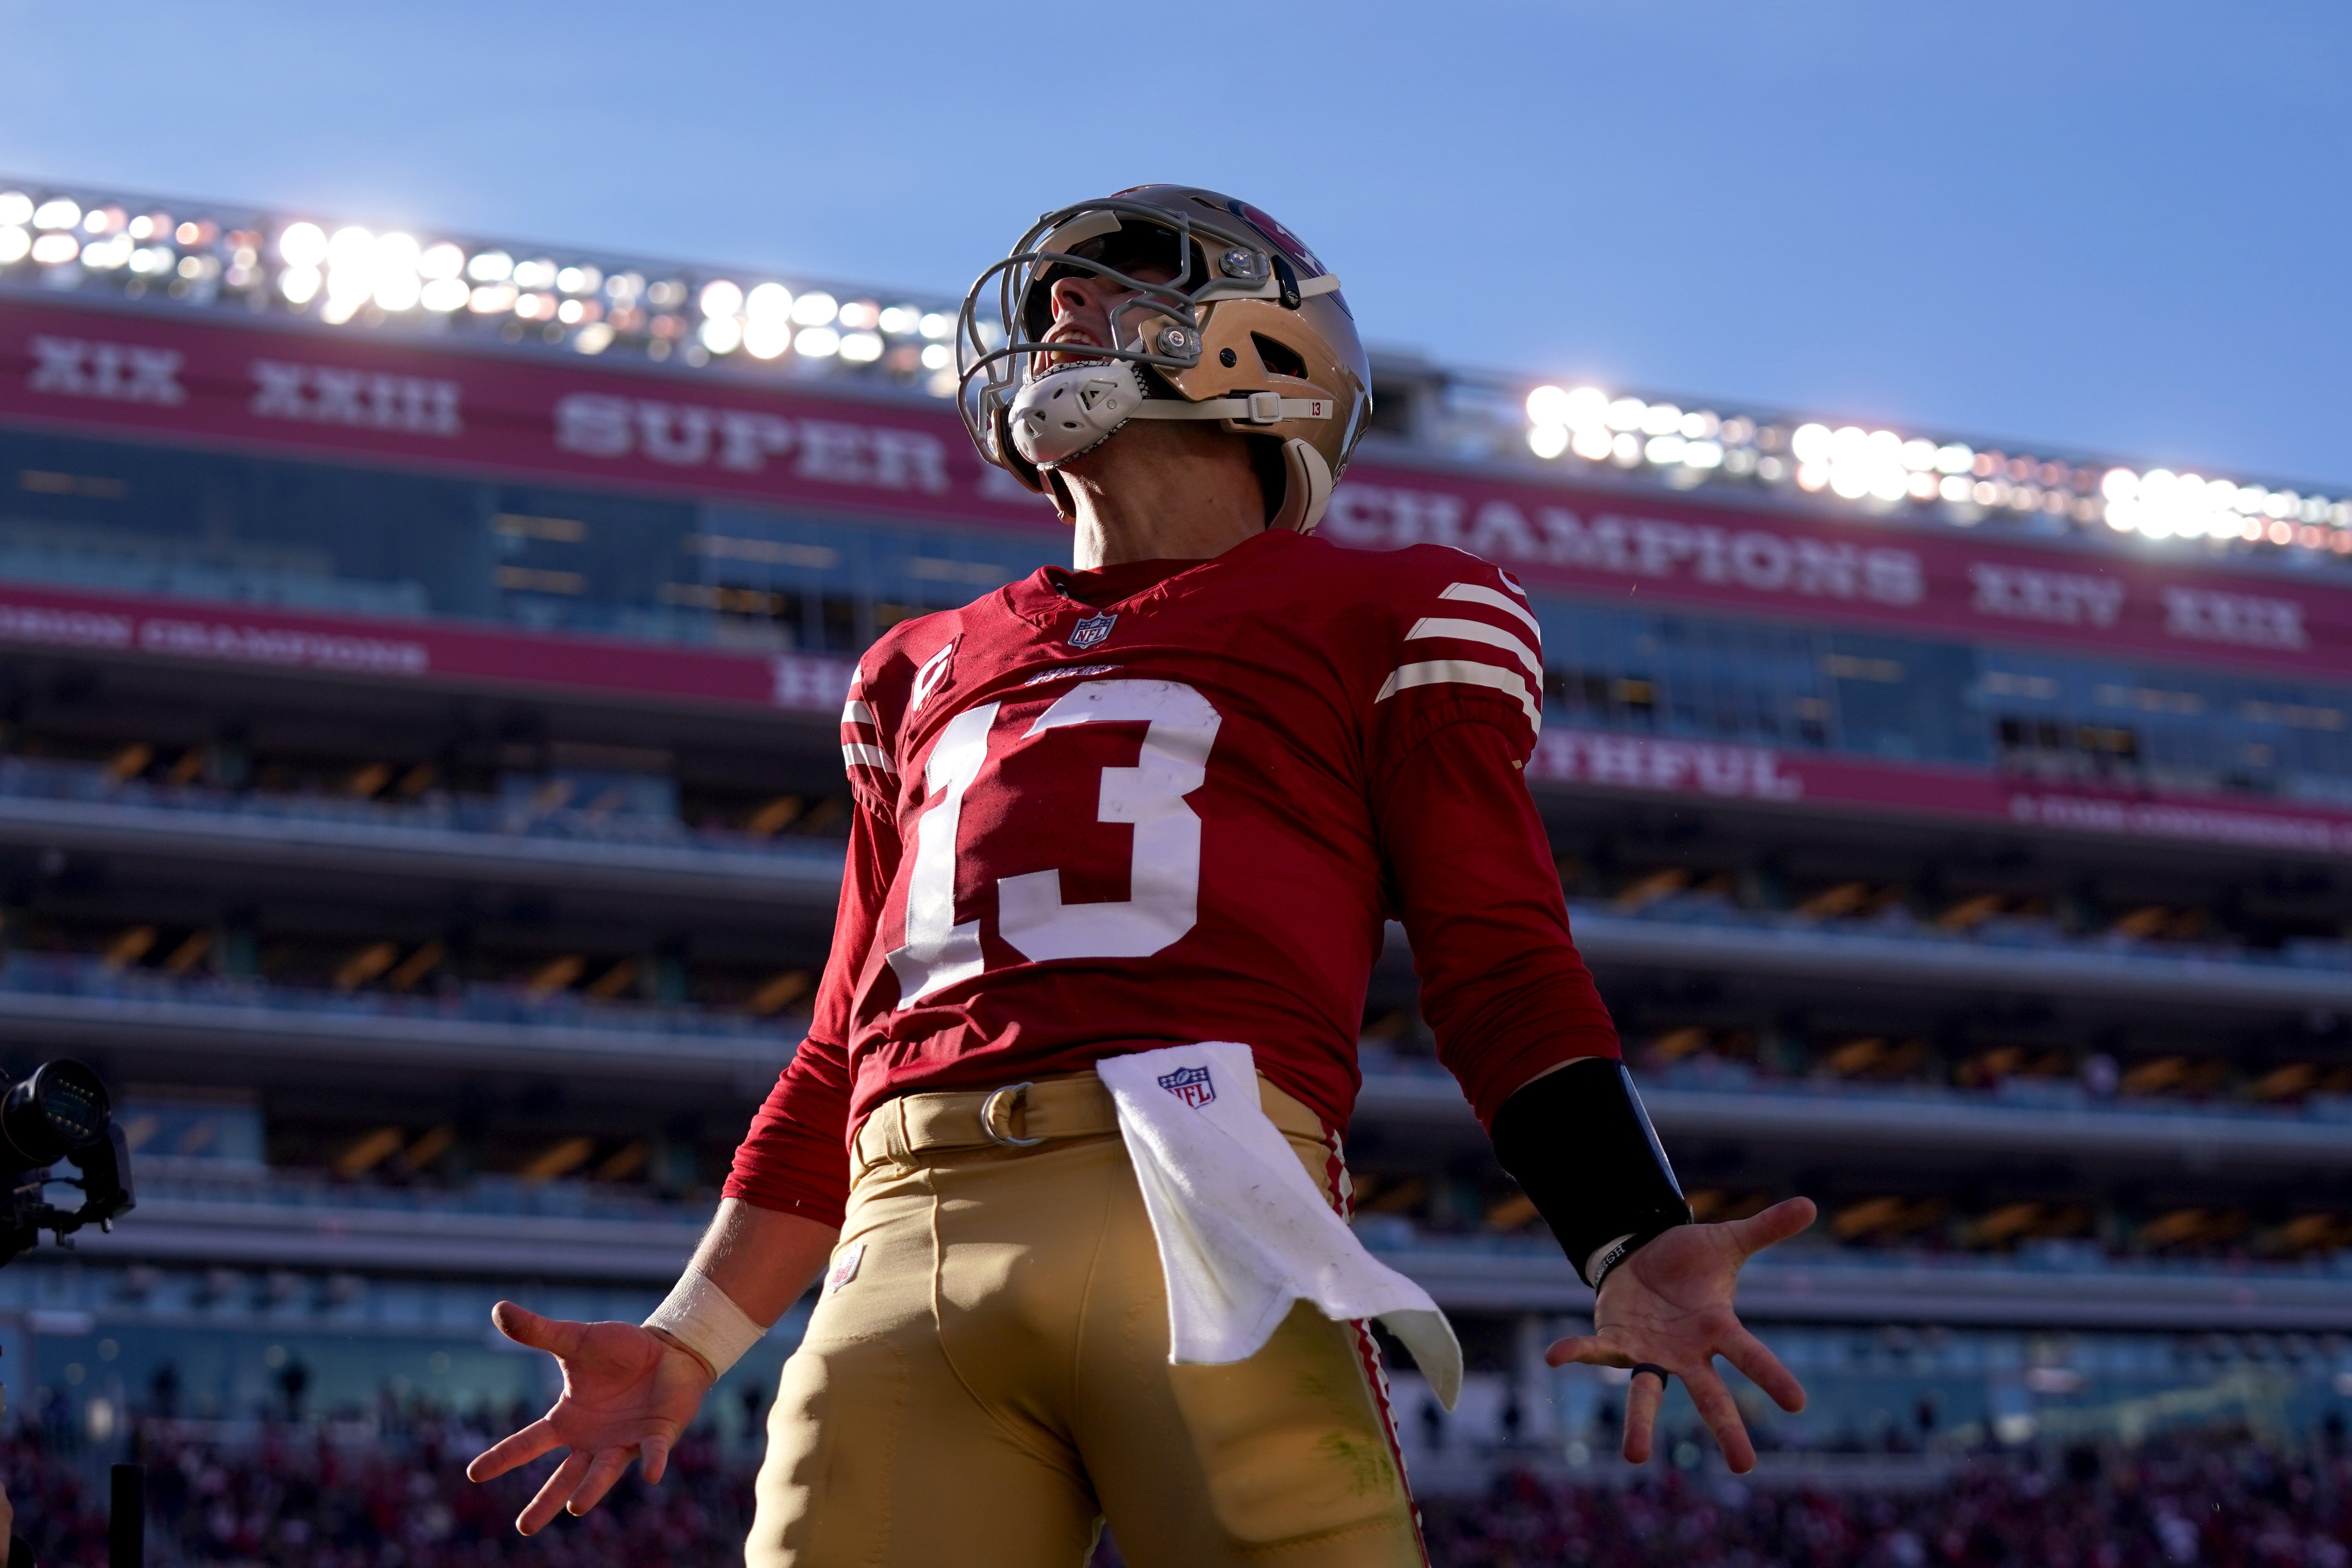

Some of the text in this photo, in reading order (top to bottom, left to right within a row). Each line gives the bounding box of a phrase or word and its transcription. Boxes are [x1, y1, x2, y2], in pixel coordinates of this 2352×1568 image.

[28, 336, 184, 404] XIX
[250, 360, 462, 434] XXIII
[556, 393, 951, 494] SUPER
[1325, 482, 1925, 606] CHAMPIONS
[1312, 402, 1321, 416] 13
[1074, 628, 1104, 642] NFL
[885, 679, 1222, 1011] 13
